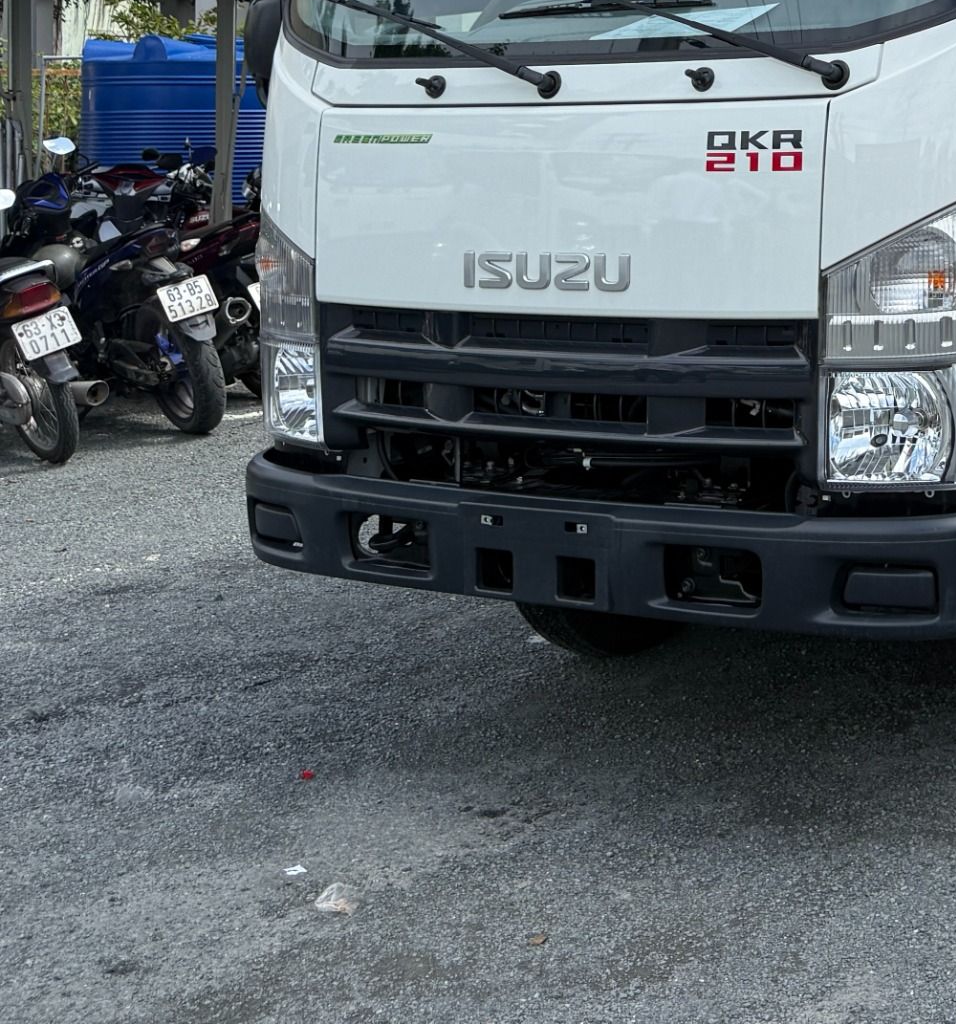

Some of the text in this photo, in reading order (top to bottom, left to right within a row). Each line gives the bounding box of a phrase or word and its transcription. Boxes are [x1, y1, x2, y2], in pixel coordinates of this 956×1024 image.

[706, 129, 803, 150] QKR
[705, 151, 803, 172] 210
[463, 250, 632, 292] ISUZU
[166, 280, 203, 303] 63-B5
[168, 293, 214, 319] 513.28
[29, 328, 71, 355] 0711
